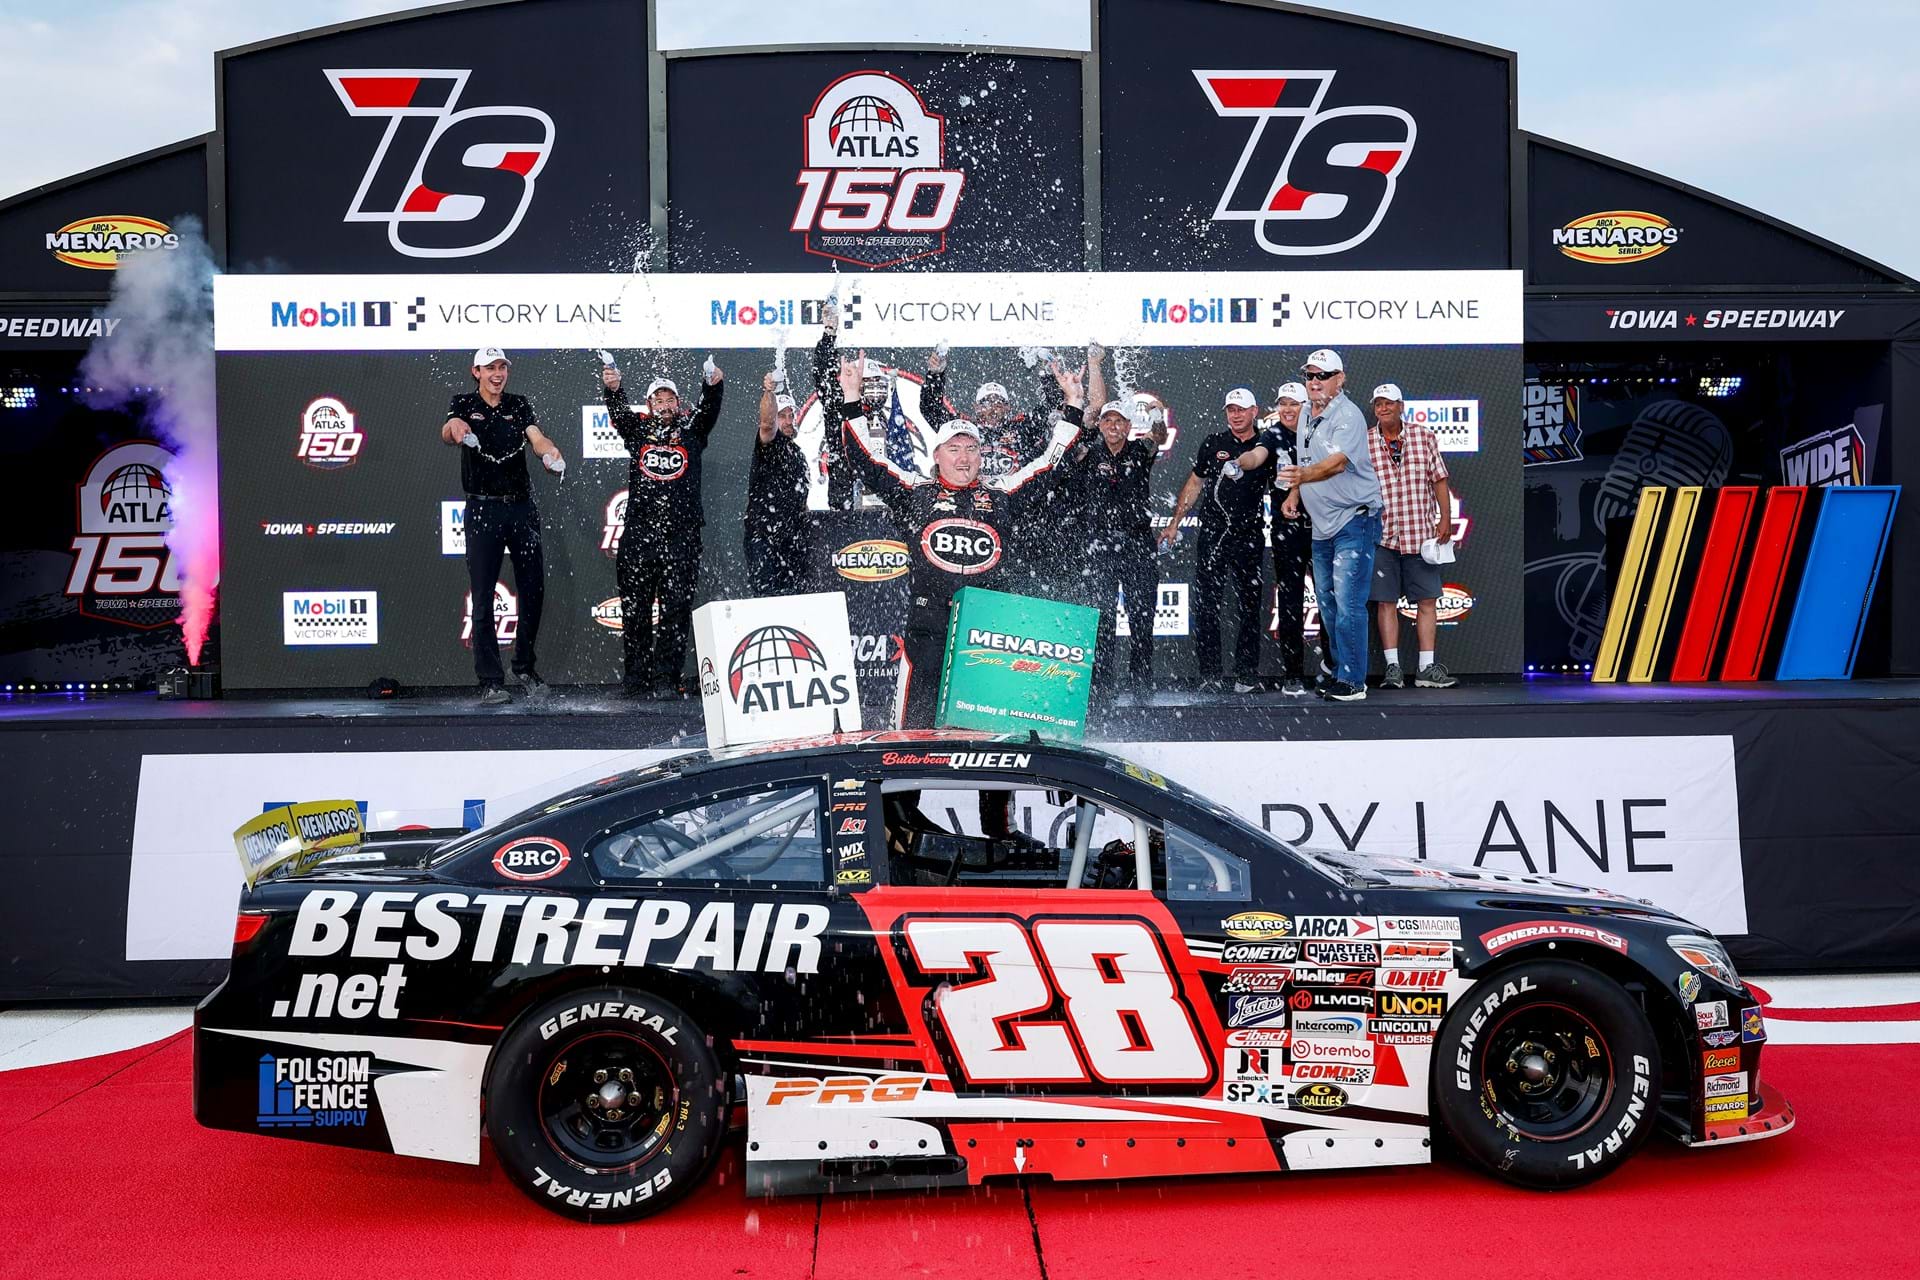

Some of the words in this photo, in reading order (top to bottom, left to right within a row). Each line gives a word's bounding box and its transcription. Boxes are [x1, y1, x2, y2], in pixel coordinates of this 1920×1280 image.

[836, 136, 919, 158] ATLAS
[790, 169, 966, 231] 150
[91, 224, 109, 232] ARCA
[1596, 219, 1613, 227] ARCA
[46, 233, 179, 250] MENARDS
[865, 236, 932, 246] SPEEDWAY
[1552, 227, 1678, 246] MENARDS
[1618, 247, 1642, 255] SERIES
[271, 301, 356, 327] Mobil
[364, 301, 391, 327] 1
[439, 304, 548, 323] VICTORY
[557, 304, 621, 323] LANE
[711, 300, 793, 325] Mobil
[875, 302, 981, 321] VICTORY
[990, 302, 1054, 321] LANE
[1142, 298, 1223, 323] Mobil
[1230, 298, 1257, 323] 1
[1303, 300, 1408, 320] VICTORY
[1417, 300, 1479, 319] LANE
[0, 318, 121, 337] PEEDWAY
[1703, 310, 1845, 329] SPEEDWAY
[1524, 385, 1563, 406] IDE
[315, 420, 346, 429] ATLAS
[297, 433, 363, 456] 150
[593, 443, 624, 452] VICTO
[1444, 437, 1469, 445] LANE
[645, 453, 682, 469] BRC
[1787, 435, 1850, 486] WIDE
[108, 502, 174, 523] ATLA
[317, 522, 395, 535] SPEEDWAY
[934, 533, 991, 556] BRC
[832, 553, 909, 567] MENARD
[96, 600, 128, 609] IOWA
[294, 600, 346, 615] Mobil
[350, 599, 367, 614] 1
[294, 629, 338, 638] VICTORY
[341, 629, 367, 638] LANE
[968, 629, 1084, 662] MENARDS
[868, 668, 899, 677] CHAMP
[704, 679, 720, 698] ATLAS
[742, 674, 850, 714] ATLAS
[956, 700, 975, 713] Shop
[977, 704, 997, 716] today
[998, 707, 1007, 716] at
[882, 752, 950, 766] Butterbean
[949, 752, 1031, 769] QUEEN
[298, 808, 359, 841] MENARDS
[840, 817, 867, 834] K1
[243, 824, 289, 863] MENARDS
[839, 841, 865, 858] WIX
[507, 850, 557, 867] BRC
[287, 890, 831, 974] BESTREPAIR
[1221, 919, 1293, 930] MENARDS
[1297, 918, 1348, 937] ARCA
[1486, 926, 1558, 950] GENERAL
[1559, 926, 1595, 938] TIRE
[1224, 946, 1298, 960] COMETIC
[1307, 943, 1373, 958] QUARTER
[1319, 953, 1377, 964] MASTER
[1231, 972, 1286, 986] KLOTZ
[1295, 969, 1345, 985] Holley
[271, 964, 407, 1019] .net
[903, 918, 1213, 1084] 28
[1314, 994, 1374, 1007] ILMOR
[1381, 995, 1442, 1014] UNOH
[539, 1002, 679, 1045] GENERAL
[1697, 1011, 1714, 1020] Sioux
[1295, 1019, 1355, 1034] Intercomp
[1371, 1021, 1428, 1033] LINCOLN
[1456, 976, 1537, 1091] GENERAL
[1226, 1029, 1289, 1047] Eibach
[1383, 1034, 1433, 1044] WELDERS
[1313, 1044, 1371, 1058] brembo
[276, 1057, 369, 1083] FOLSOM
[1296, 1064, 1356, 1079] COMP
[1335, 1075, 1364, 1084] CAMS
[1707, 1080, 1740, 1093] Richmond
[294, 1084, 368, 1109] FENCE
[765, 1076, 925, 1106] PRG
[1302, 1094, 1344, 1107] CALLIES
[1705, 1102, 1745, 1113] MENARDS
[315, 1110, 367, 1126] SUPPLY
[1567, 1054, 1650, 1170] GENERAL
[532, 1166, 673, 1209] GENERAL
